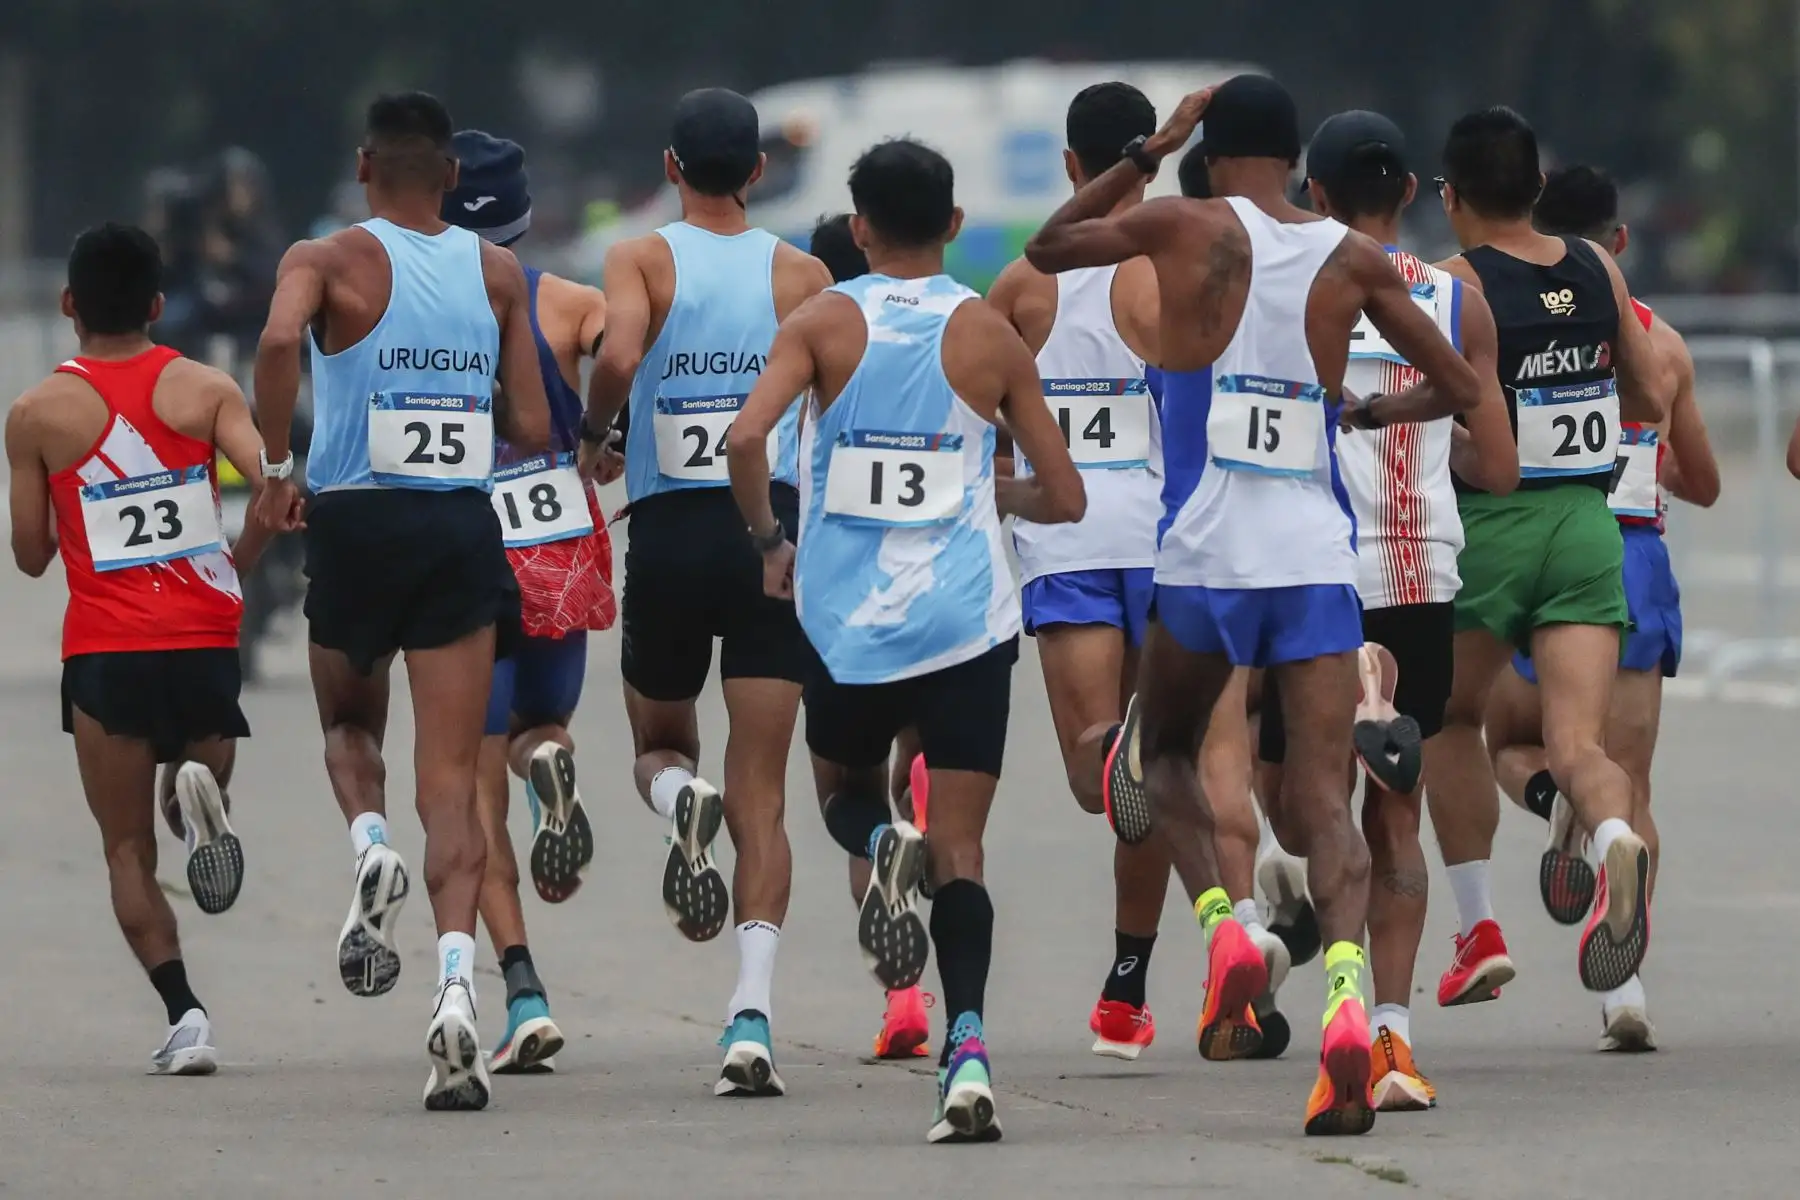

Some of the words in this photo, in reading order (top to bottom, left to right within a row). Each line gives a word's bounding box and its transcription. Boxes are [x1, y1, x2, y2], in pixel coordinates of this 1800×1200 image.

[884, 294, 919, 306] ARG
[1540, 289, 1574, 309] 100
[379, 348, 491, 377] URUGUAY
[661, 351, 768, 380] URUGUA
[1515, 339, 1611, 380] MÉXICO
[403, 421, 466, 465] 25
[1058, 406, 1115, 449] 14
[1247, 406, 1282, 453] 15
[1552, 411, 1607, 457] 20
[870, 461, 926, 507] 13
[118, 499, 183, 548] 23
[502, 483, 562, 530] 18
